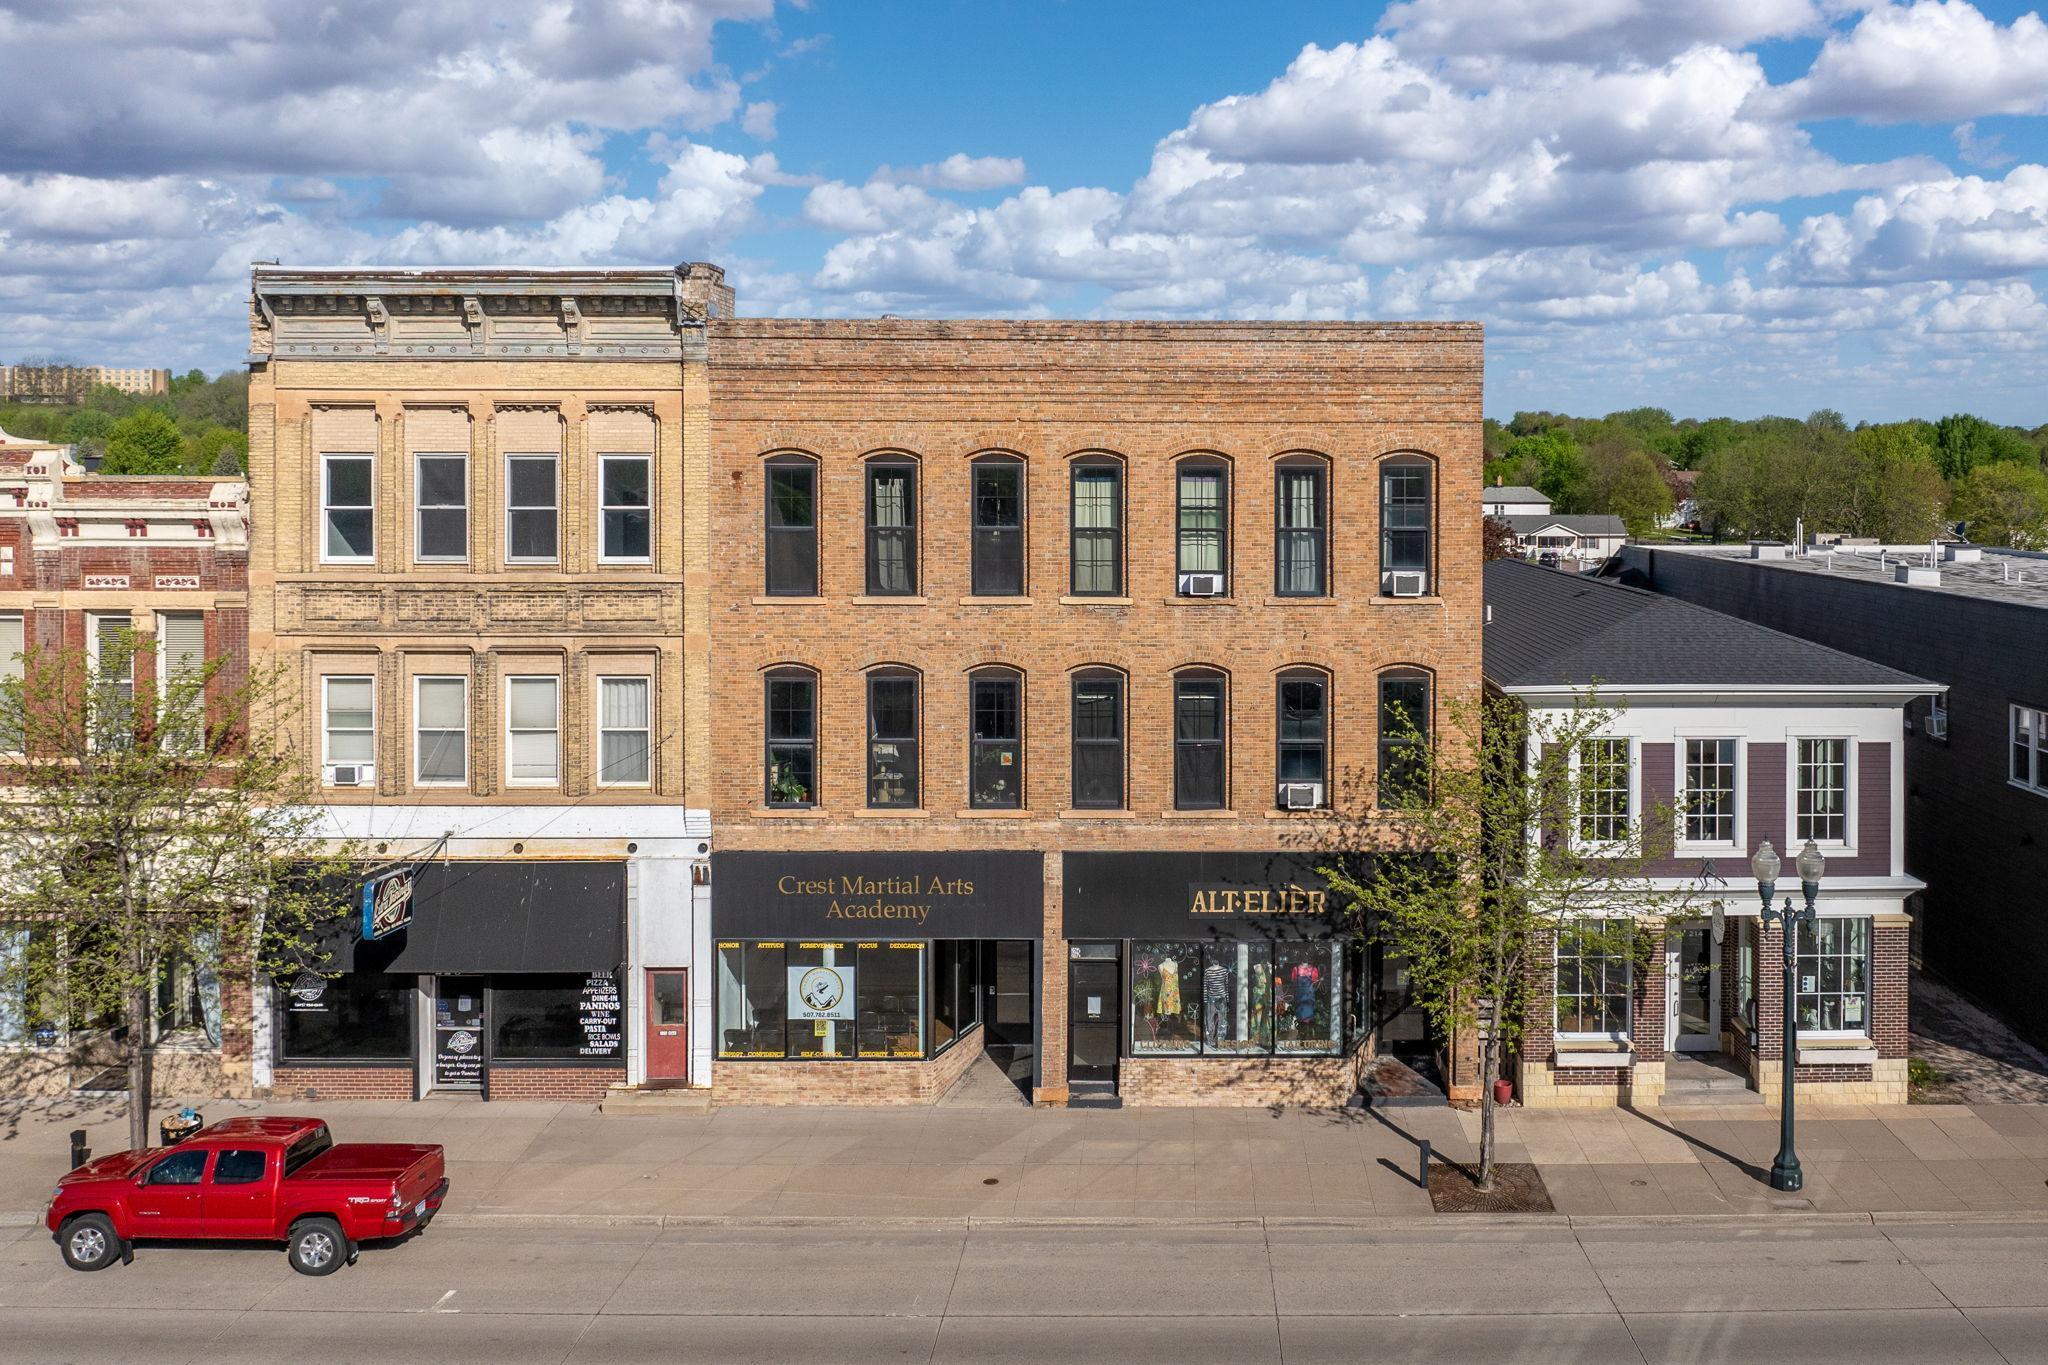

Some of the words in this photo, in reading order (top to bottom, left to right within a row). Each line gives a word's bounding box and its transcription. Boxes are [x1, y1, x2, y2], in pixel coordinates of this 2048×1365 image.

[778, 875, 836, 895] Crest
[842, 875, 920, 895] Martial
[927, 875, 974, 895] Arts
[825, 900, 932, 925] Academy
[586, 979, 609, 987] PIZZA
[582, 987, 617, 995] APPETIZERS
[580, 1002, 620, 1010] PANINOS
[591, 1010, 610, 1018] WINE
[584, 1025, 607, 1033] PASTA
[348, 1196, 369, 1204] TRD
